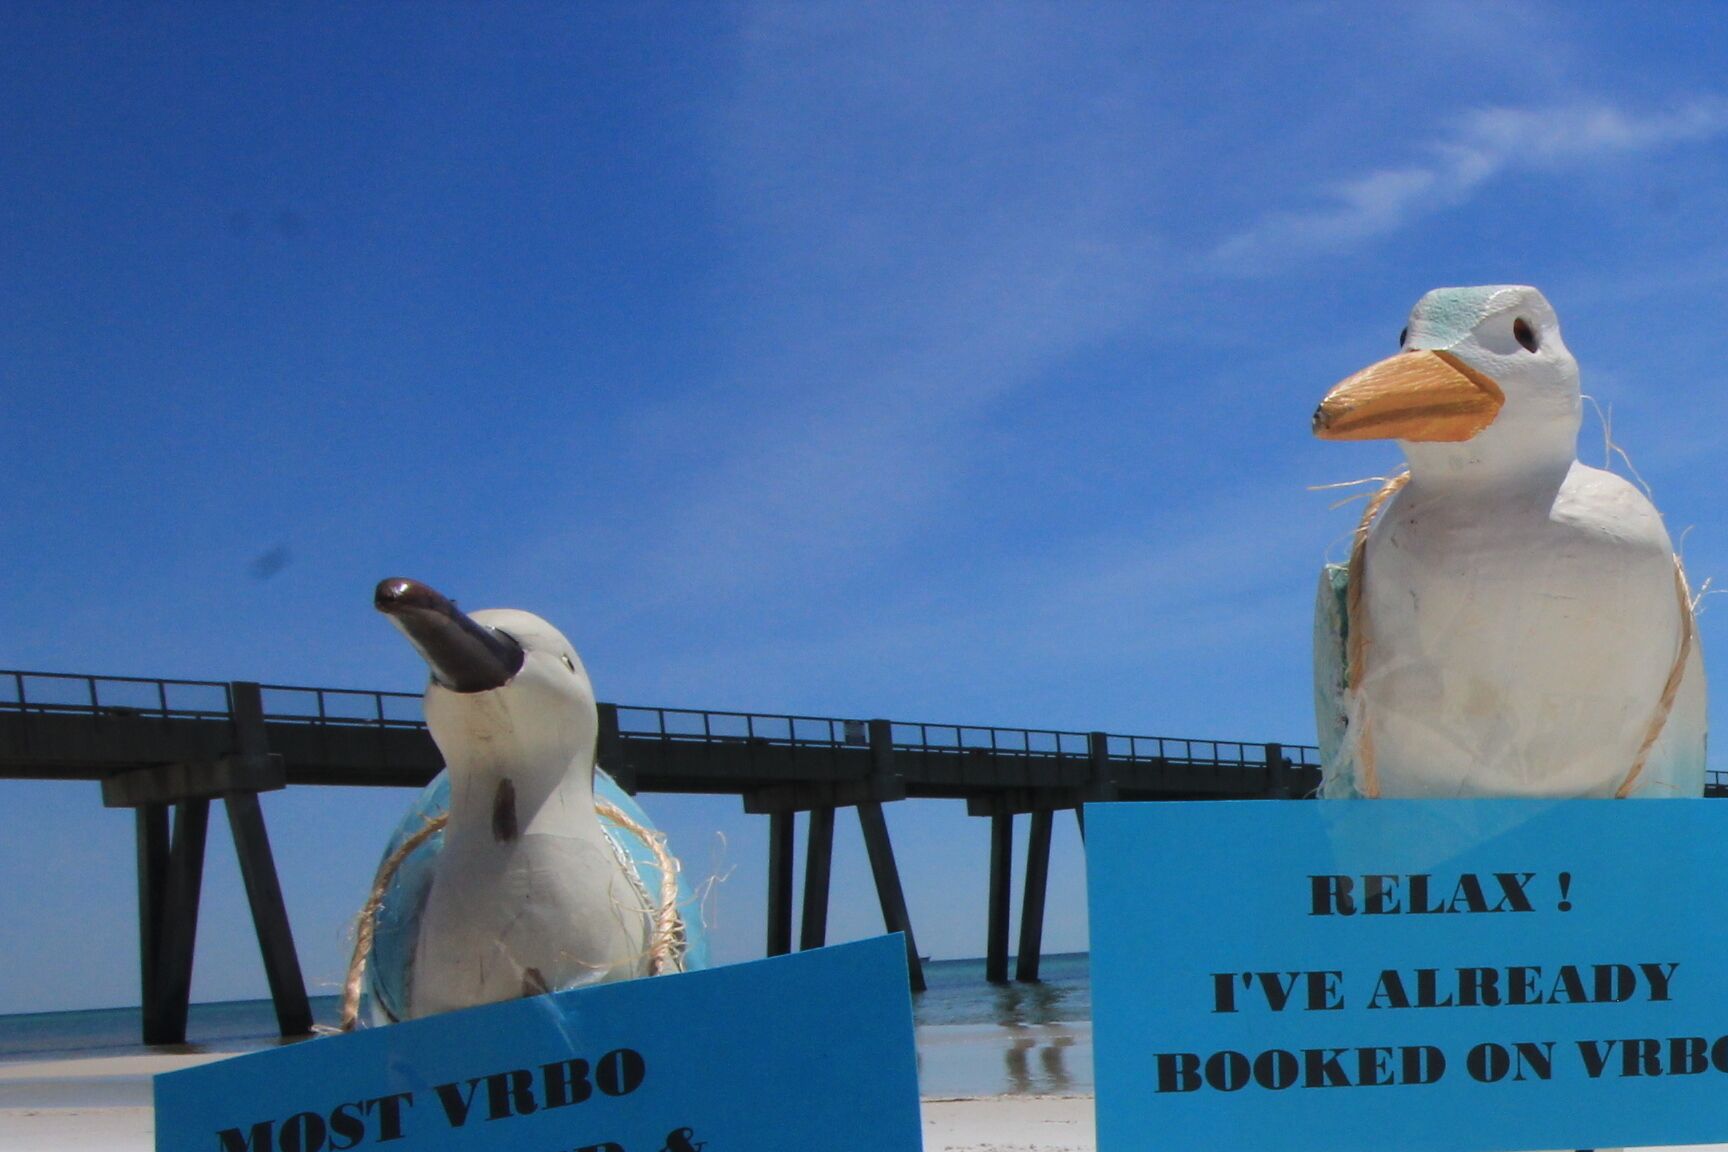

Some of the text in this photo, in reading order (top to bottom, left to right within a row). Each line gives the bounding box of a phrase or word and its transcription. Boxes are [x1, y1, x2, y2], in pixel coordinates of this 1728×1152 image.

[1308, 872, 1536, 917] RELAX
[1212, 962, 1679, 1013] I'VE ALREADY
[433, 1048, 646, 1128] VRBO
[1153, 1045, 1447, 1093] BOOKED
[1466, 1041, 1555, 1084] ON
